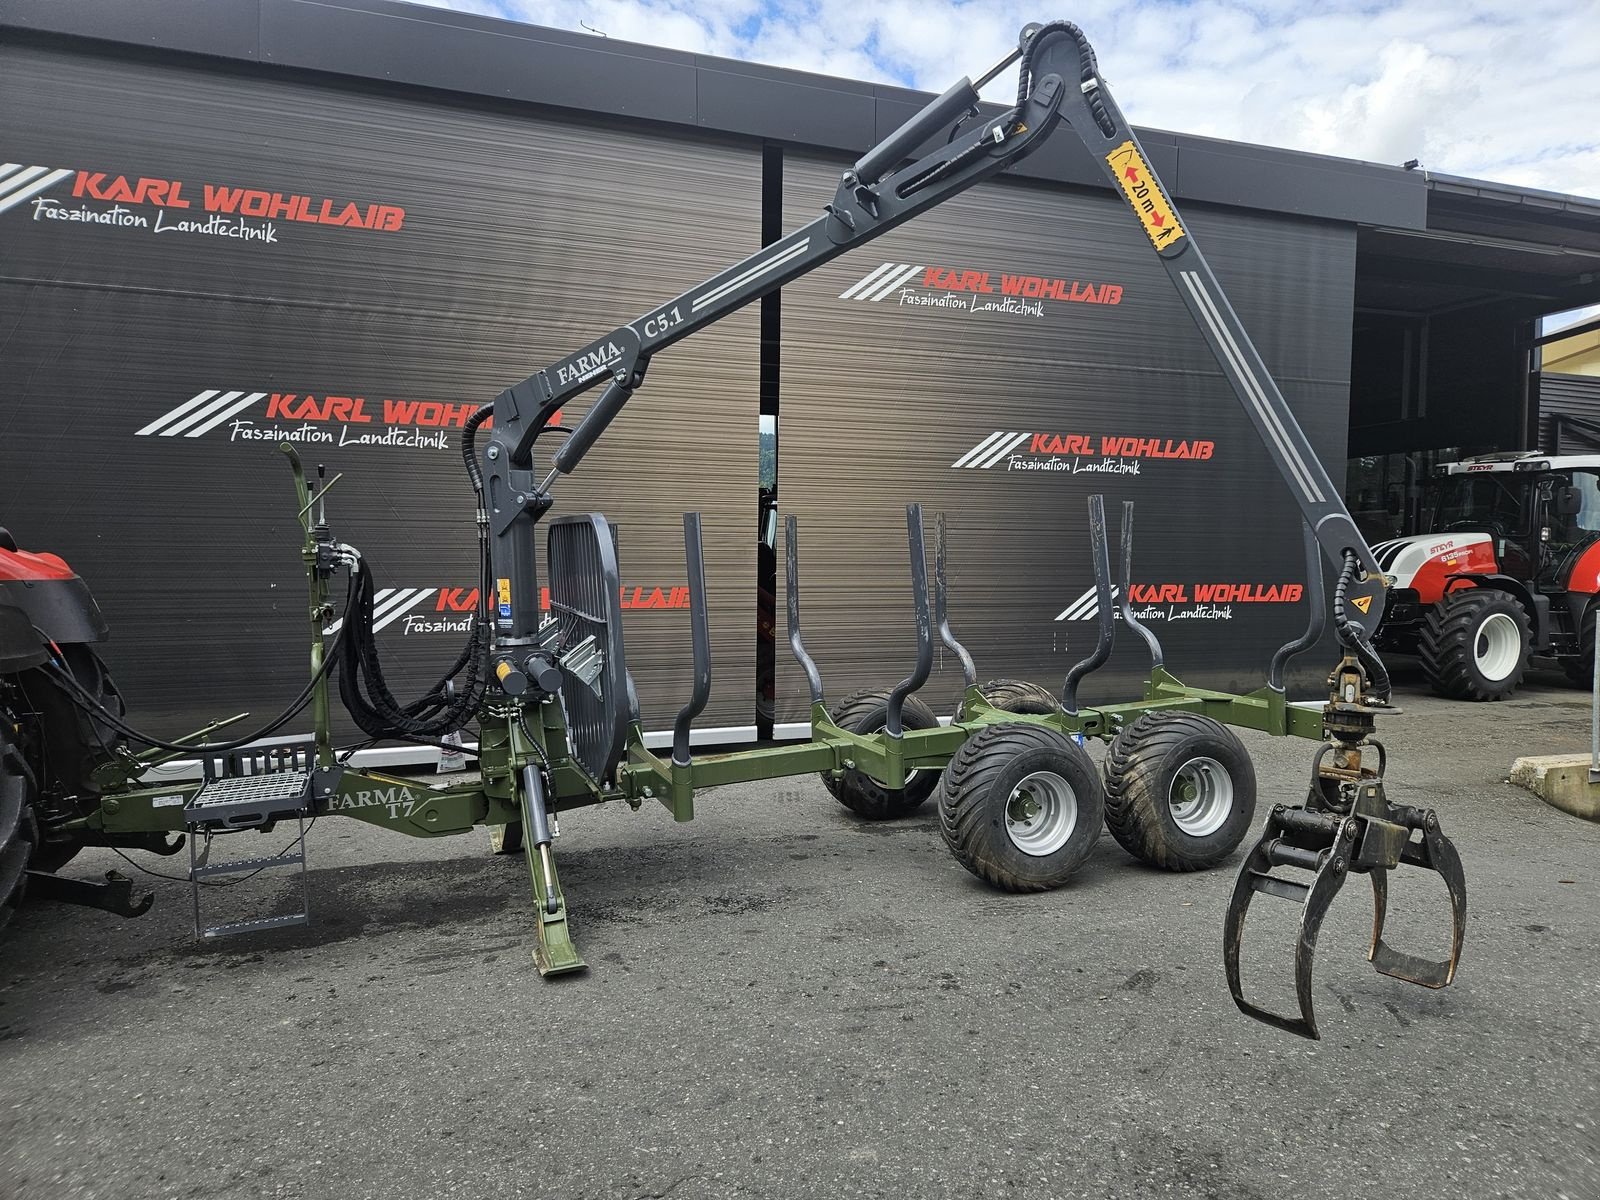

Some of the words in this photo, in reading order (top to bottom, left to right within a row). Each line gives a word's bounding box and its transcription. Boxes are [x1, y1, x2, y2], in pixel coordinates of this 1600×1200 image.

[72, 170, 190, 208] KARL
[204, 184, 405, 231] WOHLLAIB
[1132, 180, 1149, 199] 20
[1141, 198, 1155, 213] m
[31, 196, 148, 228] Faszination
[154, 209, 278, 243] Landtechnik
[923, 266, 993, 293] KARL
[1001, 274, 1124, 305] WOHLLAIB
[899, 287, 967, 309] Faszination
[970, 294, 1044, 317] Landtechnik
[265, 393, 372, 423] KARL
[229, 419, 333, 442] Faszination
[339, 424, 449, 450] Landtechnik
[1030, 433, 1095, 455] KARL
[1102, 436, 1215, 460] WOHLLAIB
[1007, 454, 1070, 471] Faszination
[1073, 457, 1141, 475] Landtechnik
[1430, 540, 1454, 554] STEYR
[1128, 584, 1187, 603] KARL
[1194, 584, 1304, 603] WOHLLAIB
[1168, 605, 1232, 622] Landtechnik
[385, 801, 415, 819] T7
